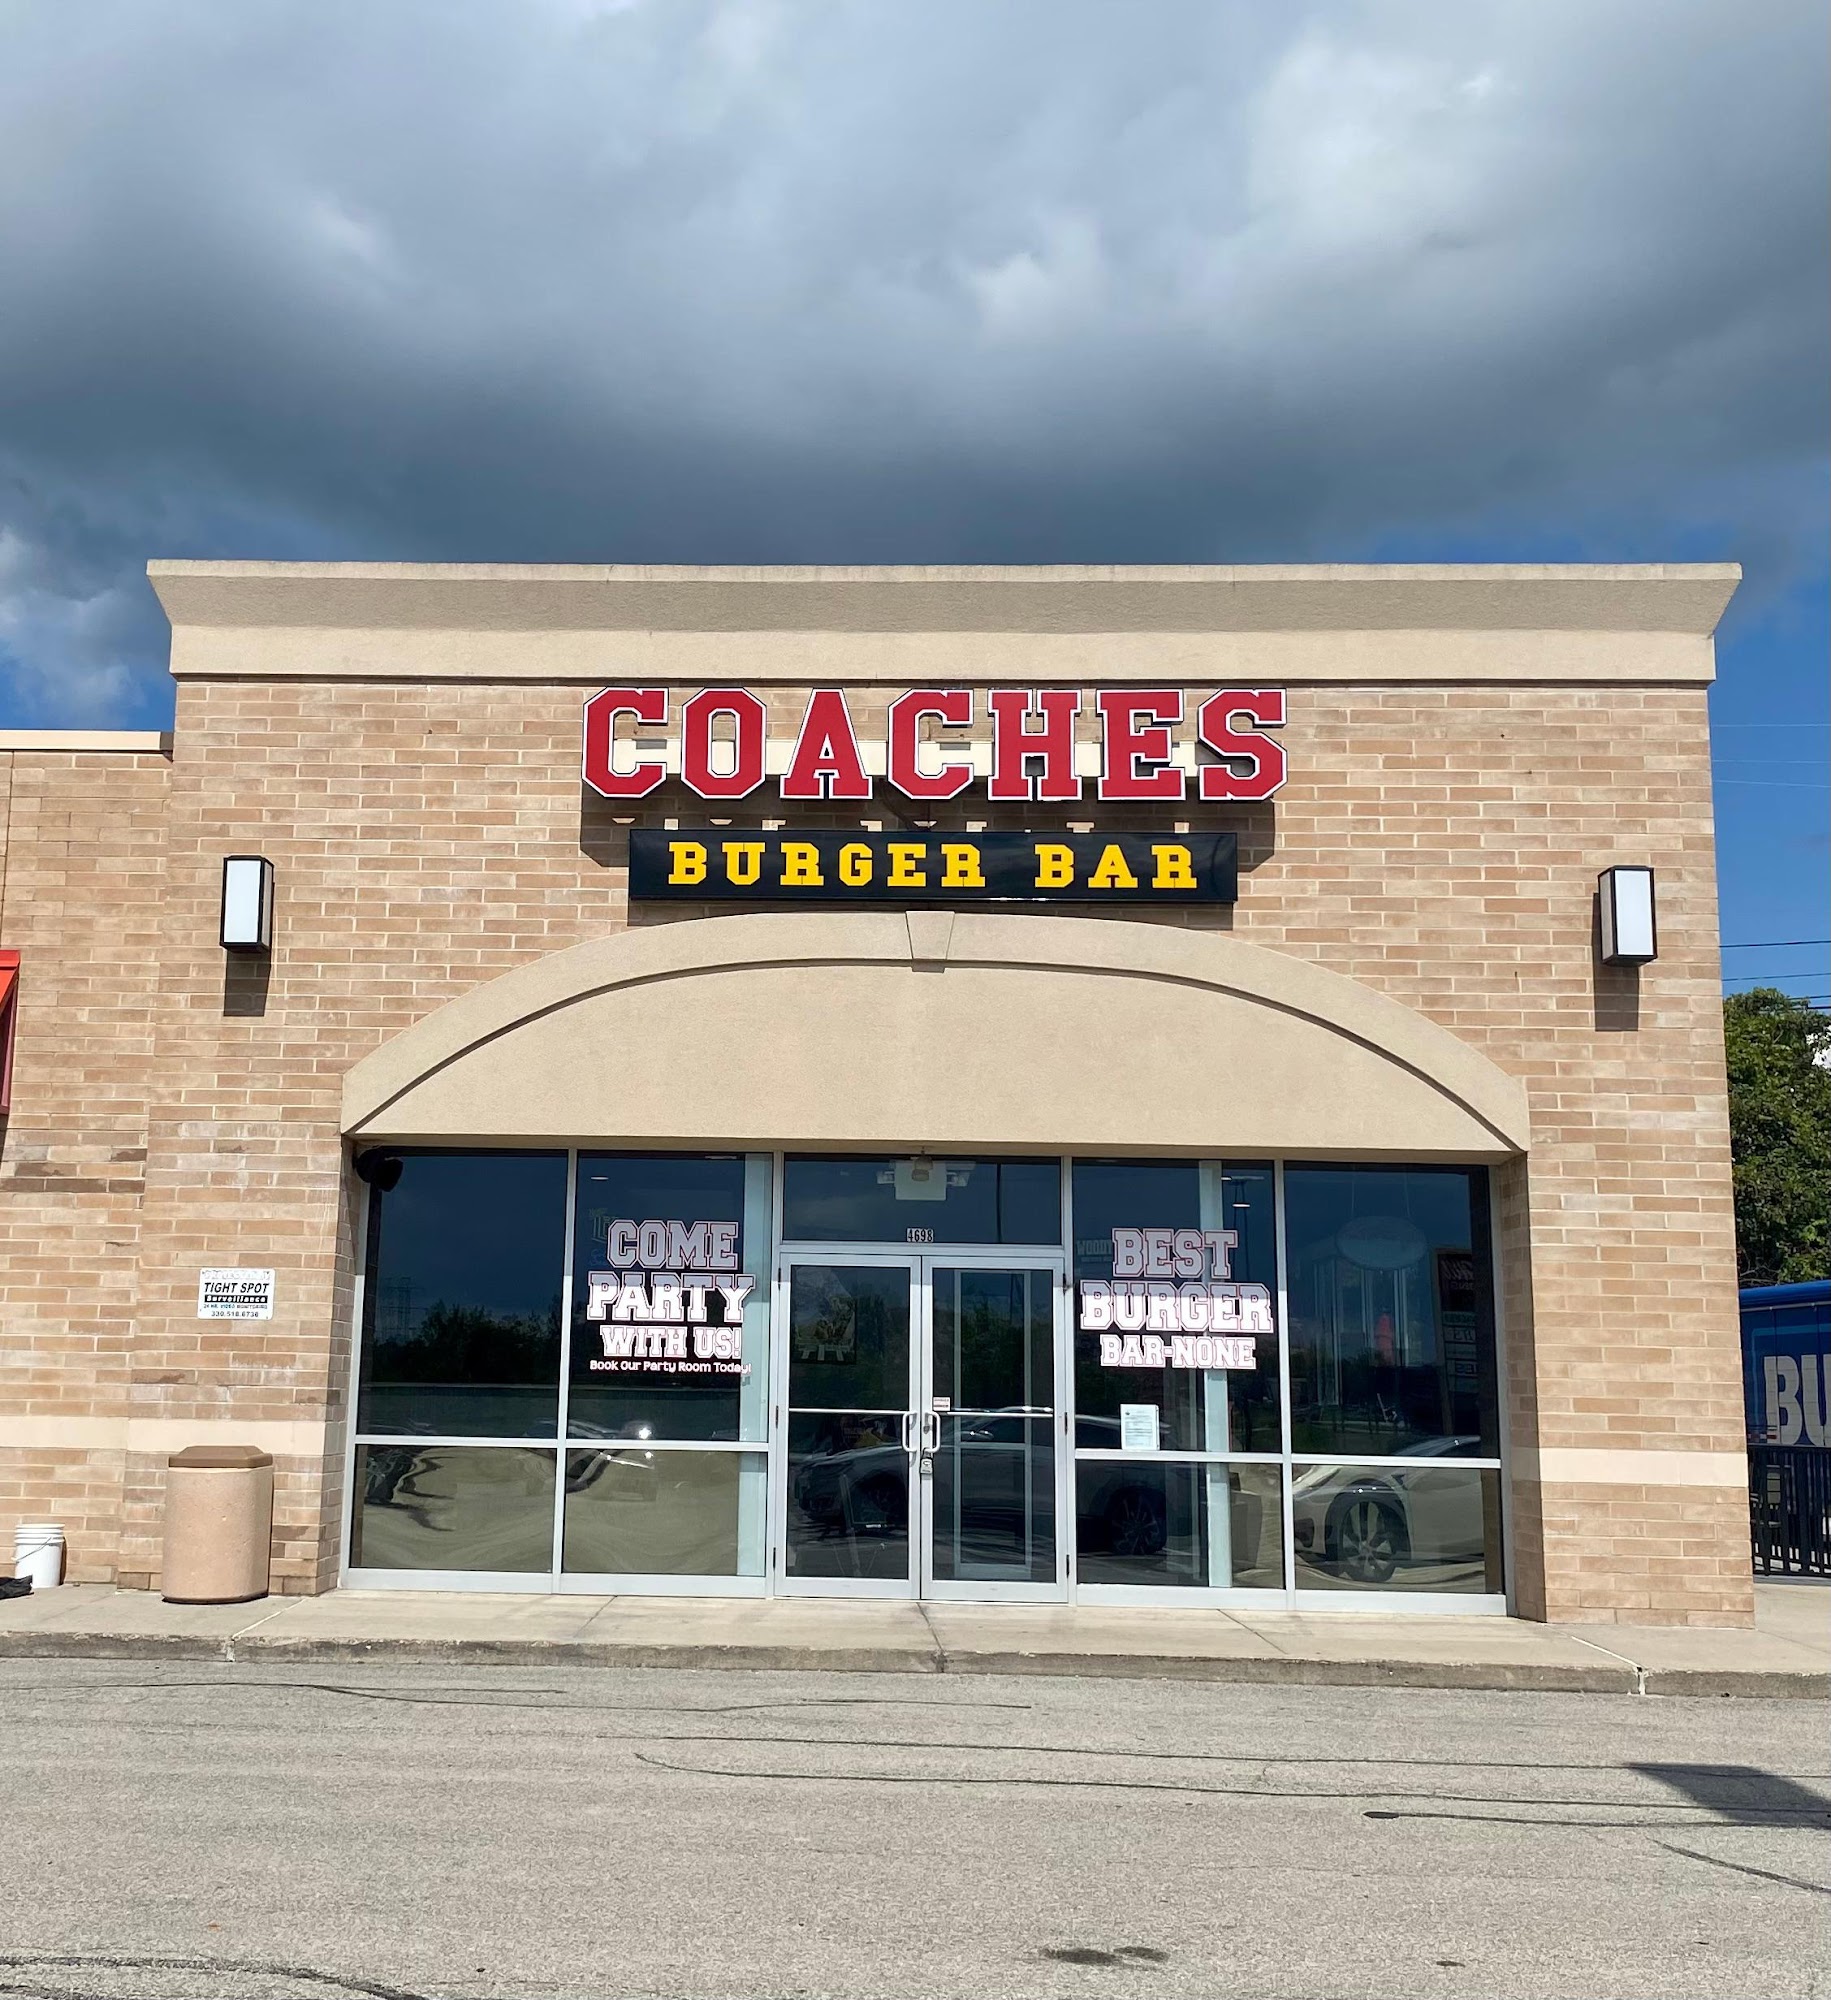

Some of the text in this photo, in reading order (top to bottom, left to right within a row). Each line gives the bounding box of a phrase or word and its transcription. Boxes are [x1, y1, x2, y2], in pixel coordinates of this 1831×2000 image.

[581, 687, 1288, 801] COACHES
[668, 841, 1198, 889] BURGER BAR
[607, 1219, 739, 1270] COME
[907, 1229, 933, 1242] 4698
[1112, 1228, 1238, 1279] BEST
[204, 1282, 269, 1293] TIGHT SPOT
[587, 1271, 756, 1322] PARTY
[1080, 1279, 1274, 1333] BURGER
[600, 1325, 742, 1359] WITH US!
[1100, 1334, 1257, 1369] BAR-NONE
[590, 1360, 751, 1373] Book Our Party Room Today!
